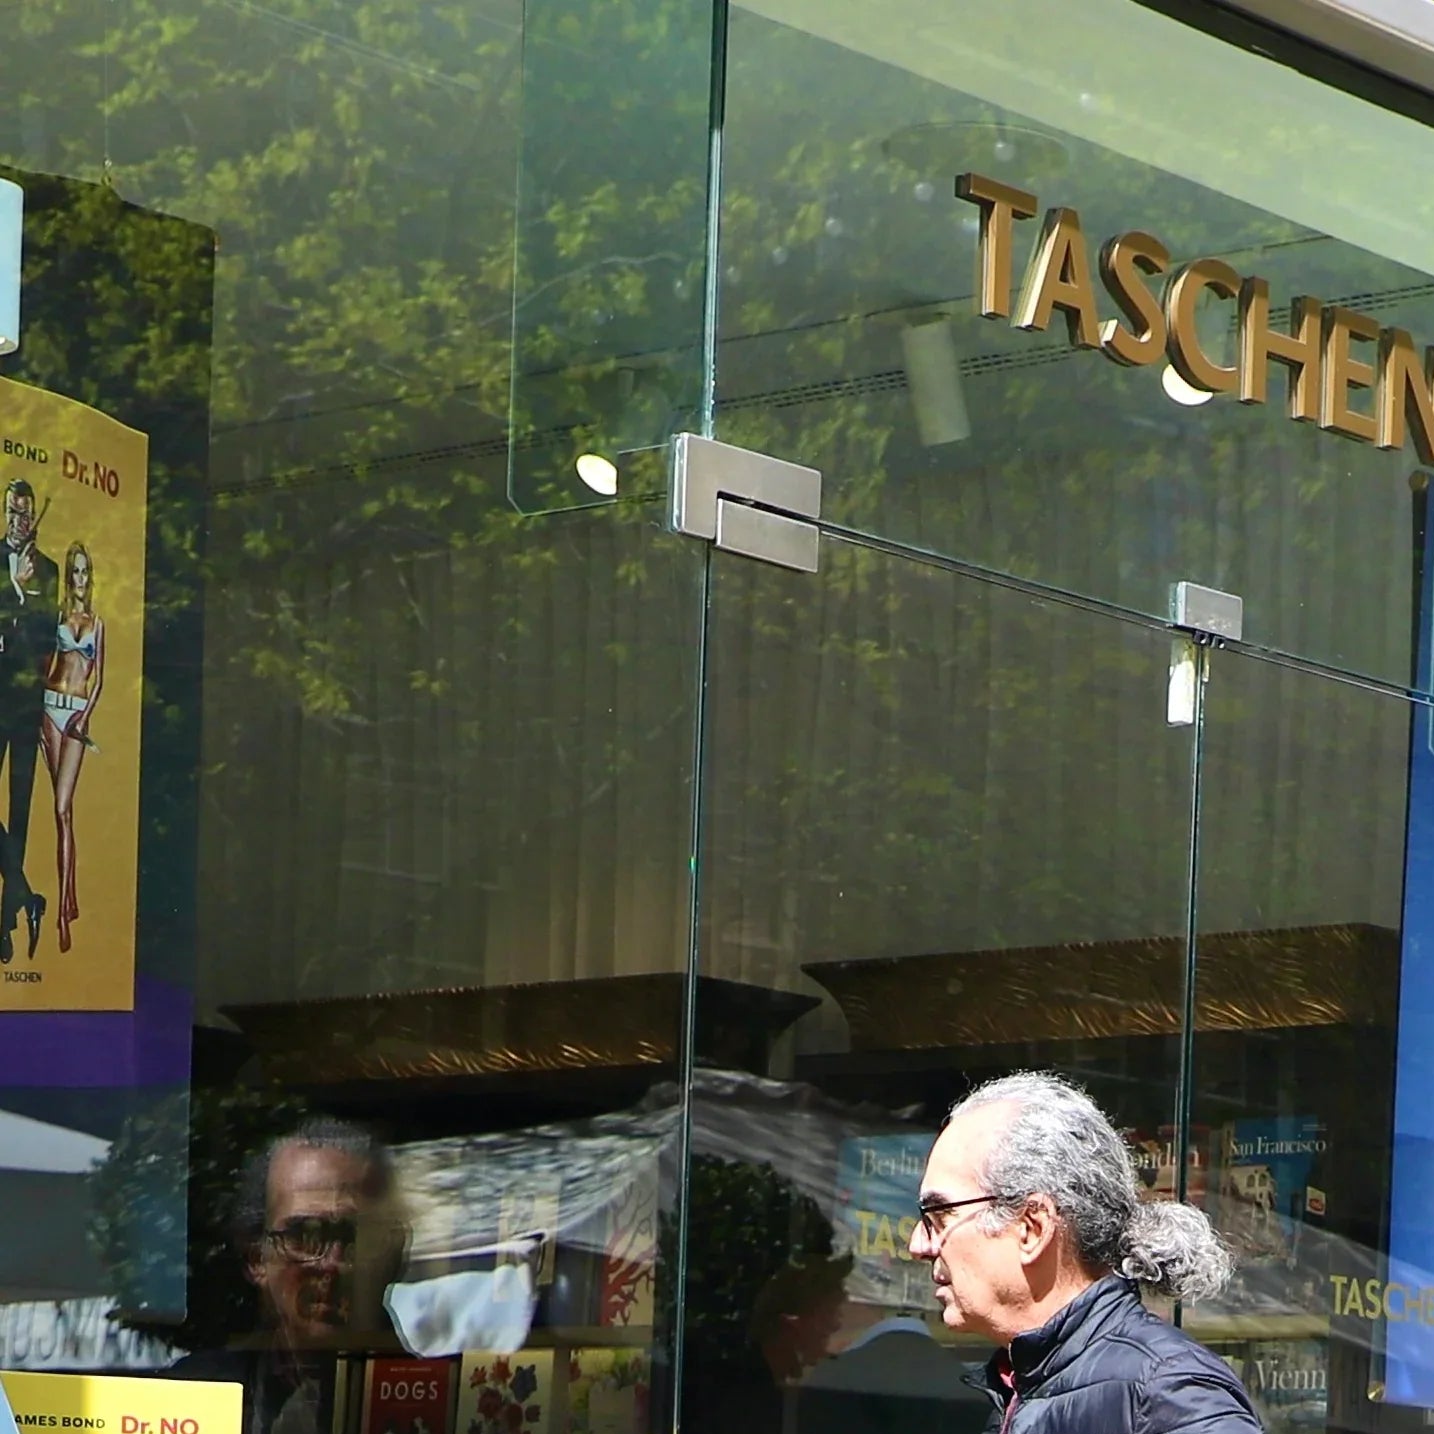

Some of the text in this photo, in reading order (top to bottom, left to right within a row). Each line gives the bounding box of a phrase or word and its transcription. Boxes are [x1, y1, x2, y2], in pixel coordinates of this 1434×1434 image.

[3, 439, 48, 463] BOND
[3, 971, 42, 983] TASCHEN
[1131, 1142, 1200, 1170] ondn
[1229, 1134, 1327, 1157] San Francisco
[1253, 1359, 1327, 1391] Vienn
[379, 1380, 439, 1401] DOGS
[15, 1413, 57, 1427] AMES
[62, 1416, 106, 1429] BOND
